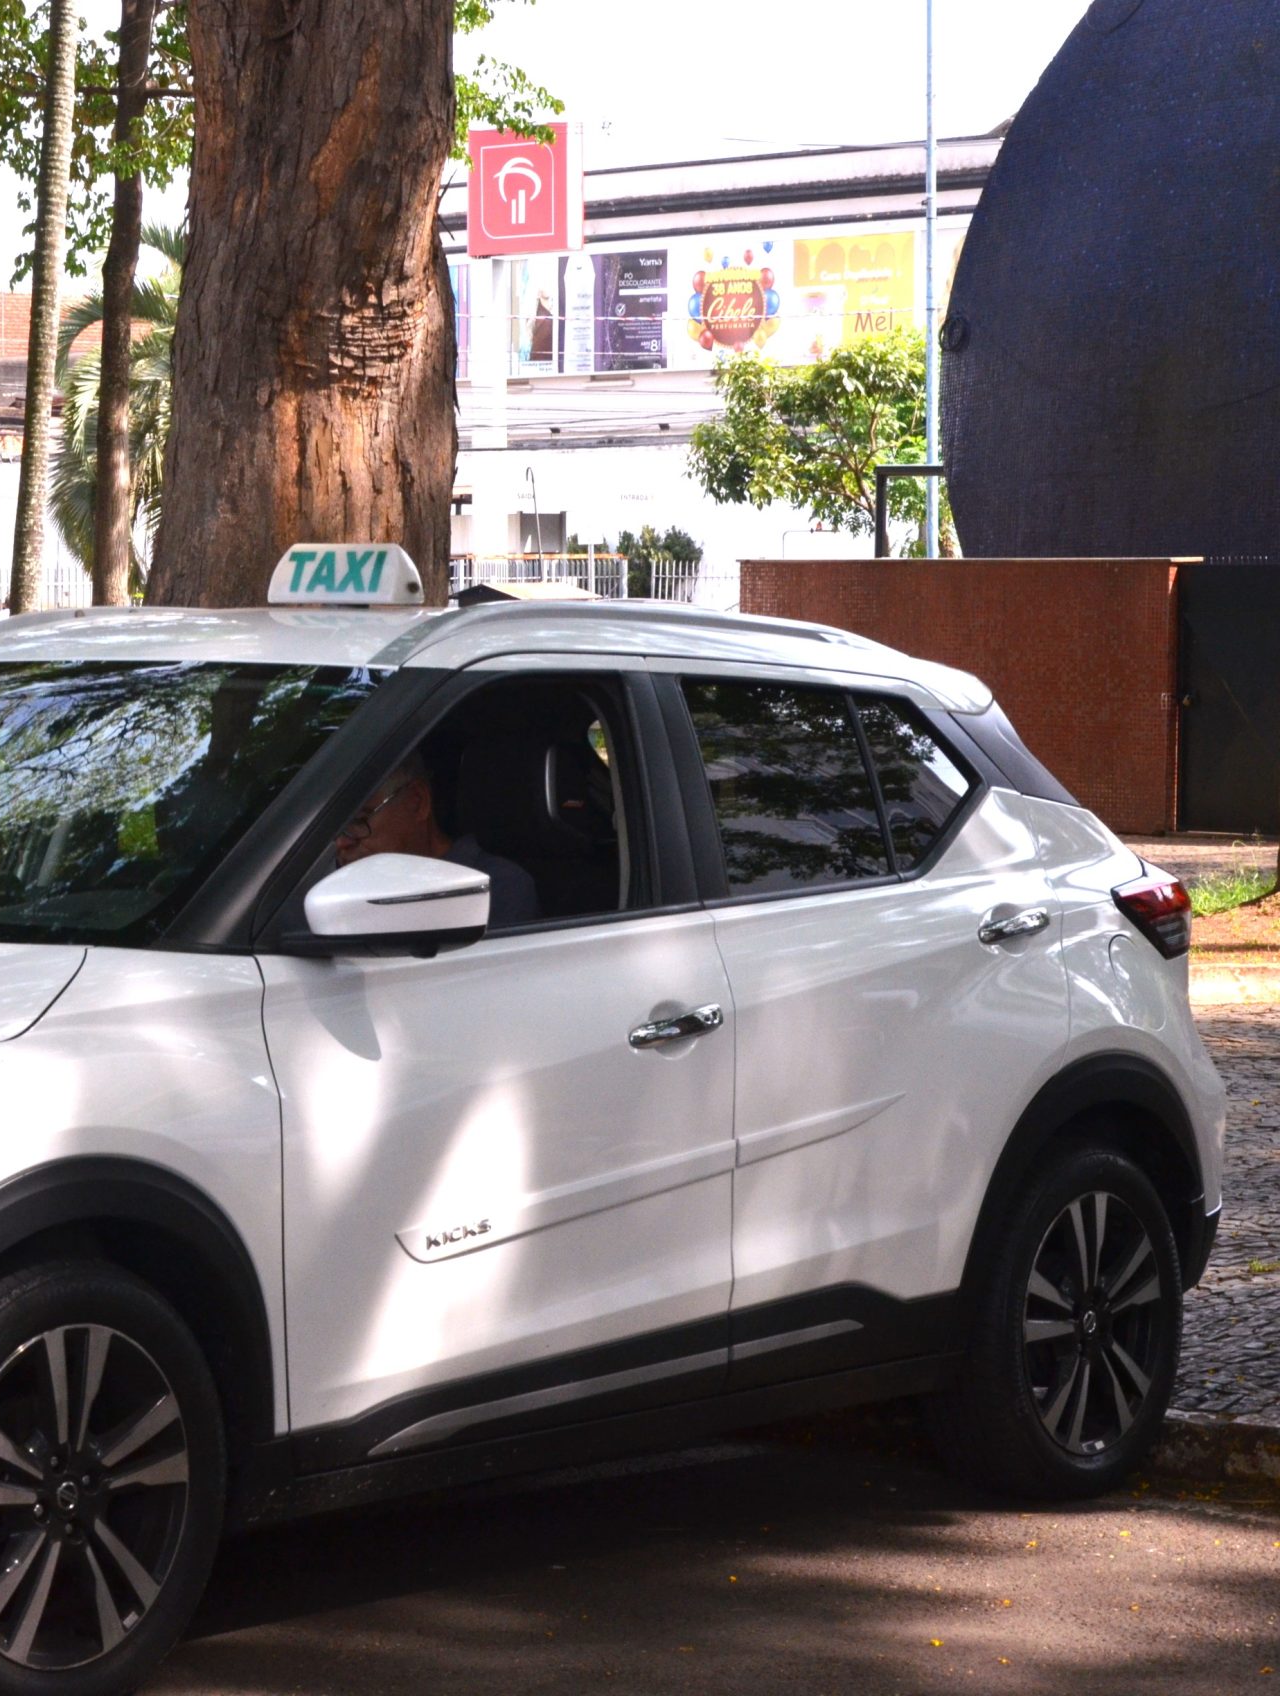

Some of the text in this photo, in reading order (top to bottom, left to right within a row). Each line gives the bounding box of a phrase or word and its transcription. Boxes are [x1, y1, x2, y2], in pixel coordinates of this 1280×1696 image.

[619, 279, 661, 287] DESCOLORANTE
[727, 281, 753, 294] ANOS
[708, 297, 756, 323] Cibele
[854, 307, 893, 333] Mel
[711, 322, 755, 330] PERFUMARIA
[288, 551, 388, 593] TAXI
[426, 1218, 491, 1250] KICKS
